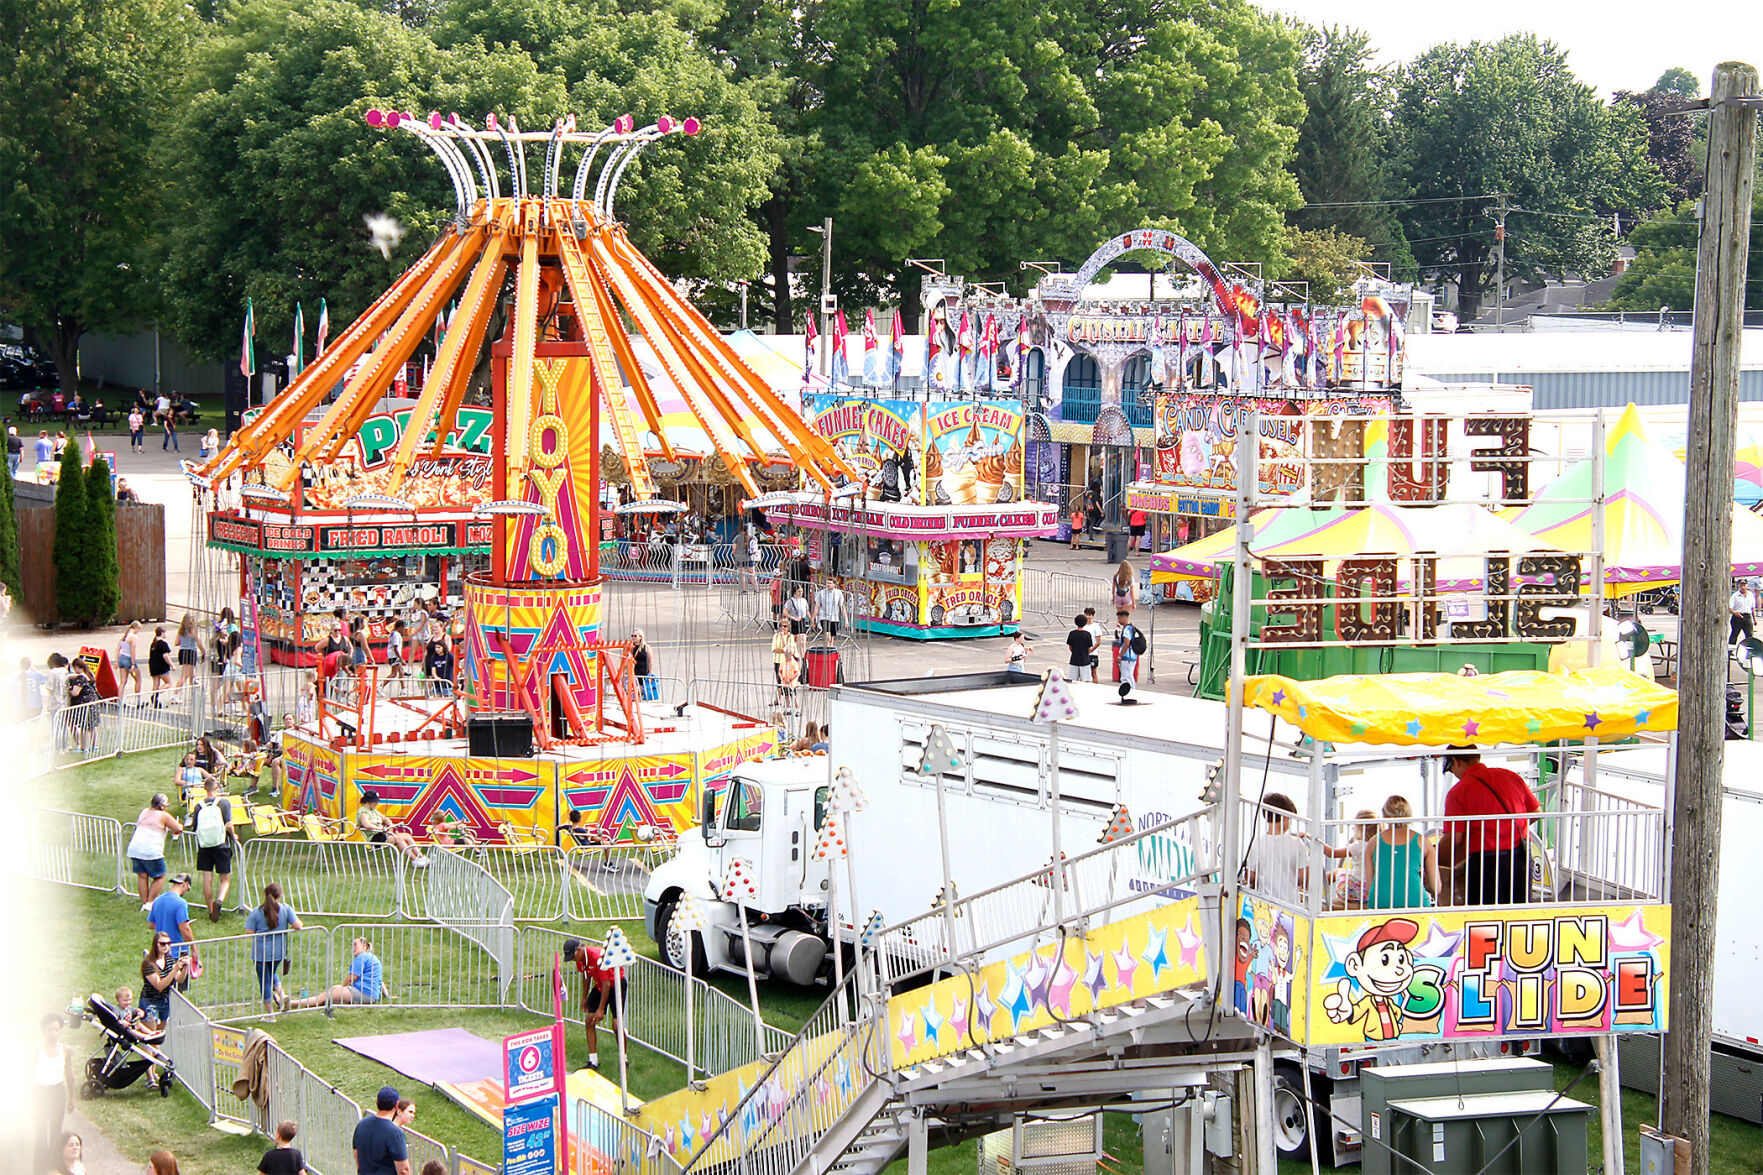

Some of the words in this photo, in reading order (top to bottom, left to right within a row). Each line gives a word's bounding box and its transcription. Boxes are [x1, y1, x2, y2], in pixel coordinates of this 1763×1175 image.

[1067, 315, 1147, 344] CRYSTAL
[1152, 317, 1225, 346] CATE
[817, 404, 864, 438] FUNNEL
[868, 408, 908, 451] CAKES
[936, 411, 959, 431] ICE
[1165, 404, 1213, 435] CANDY
[1218, 400, 1298, 446] CARUSEL
[1129, 494, 1170, 512] NACHOS
[1178, 499, 1199, 514] COTTON
[1200, 501, 1220, 515] CANDY
[952, 514, 998, 529] FUNNEL
[999, 513, 1036, 527] CAKES
[264, 527, 282, 538] ICE
[328, 528, 379, 548] FRIED
[382, 527, 448, 546] RAVIOLI
[1465, 915, 1608, 974] FUN
[1400, 957, 1653, 1027] SLIDE
[523, 1050, 537, 1069] 6
[507, 1123, 527, 1137] SIZE
[527, 1117, 550, 1132] WIZE
